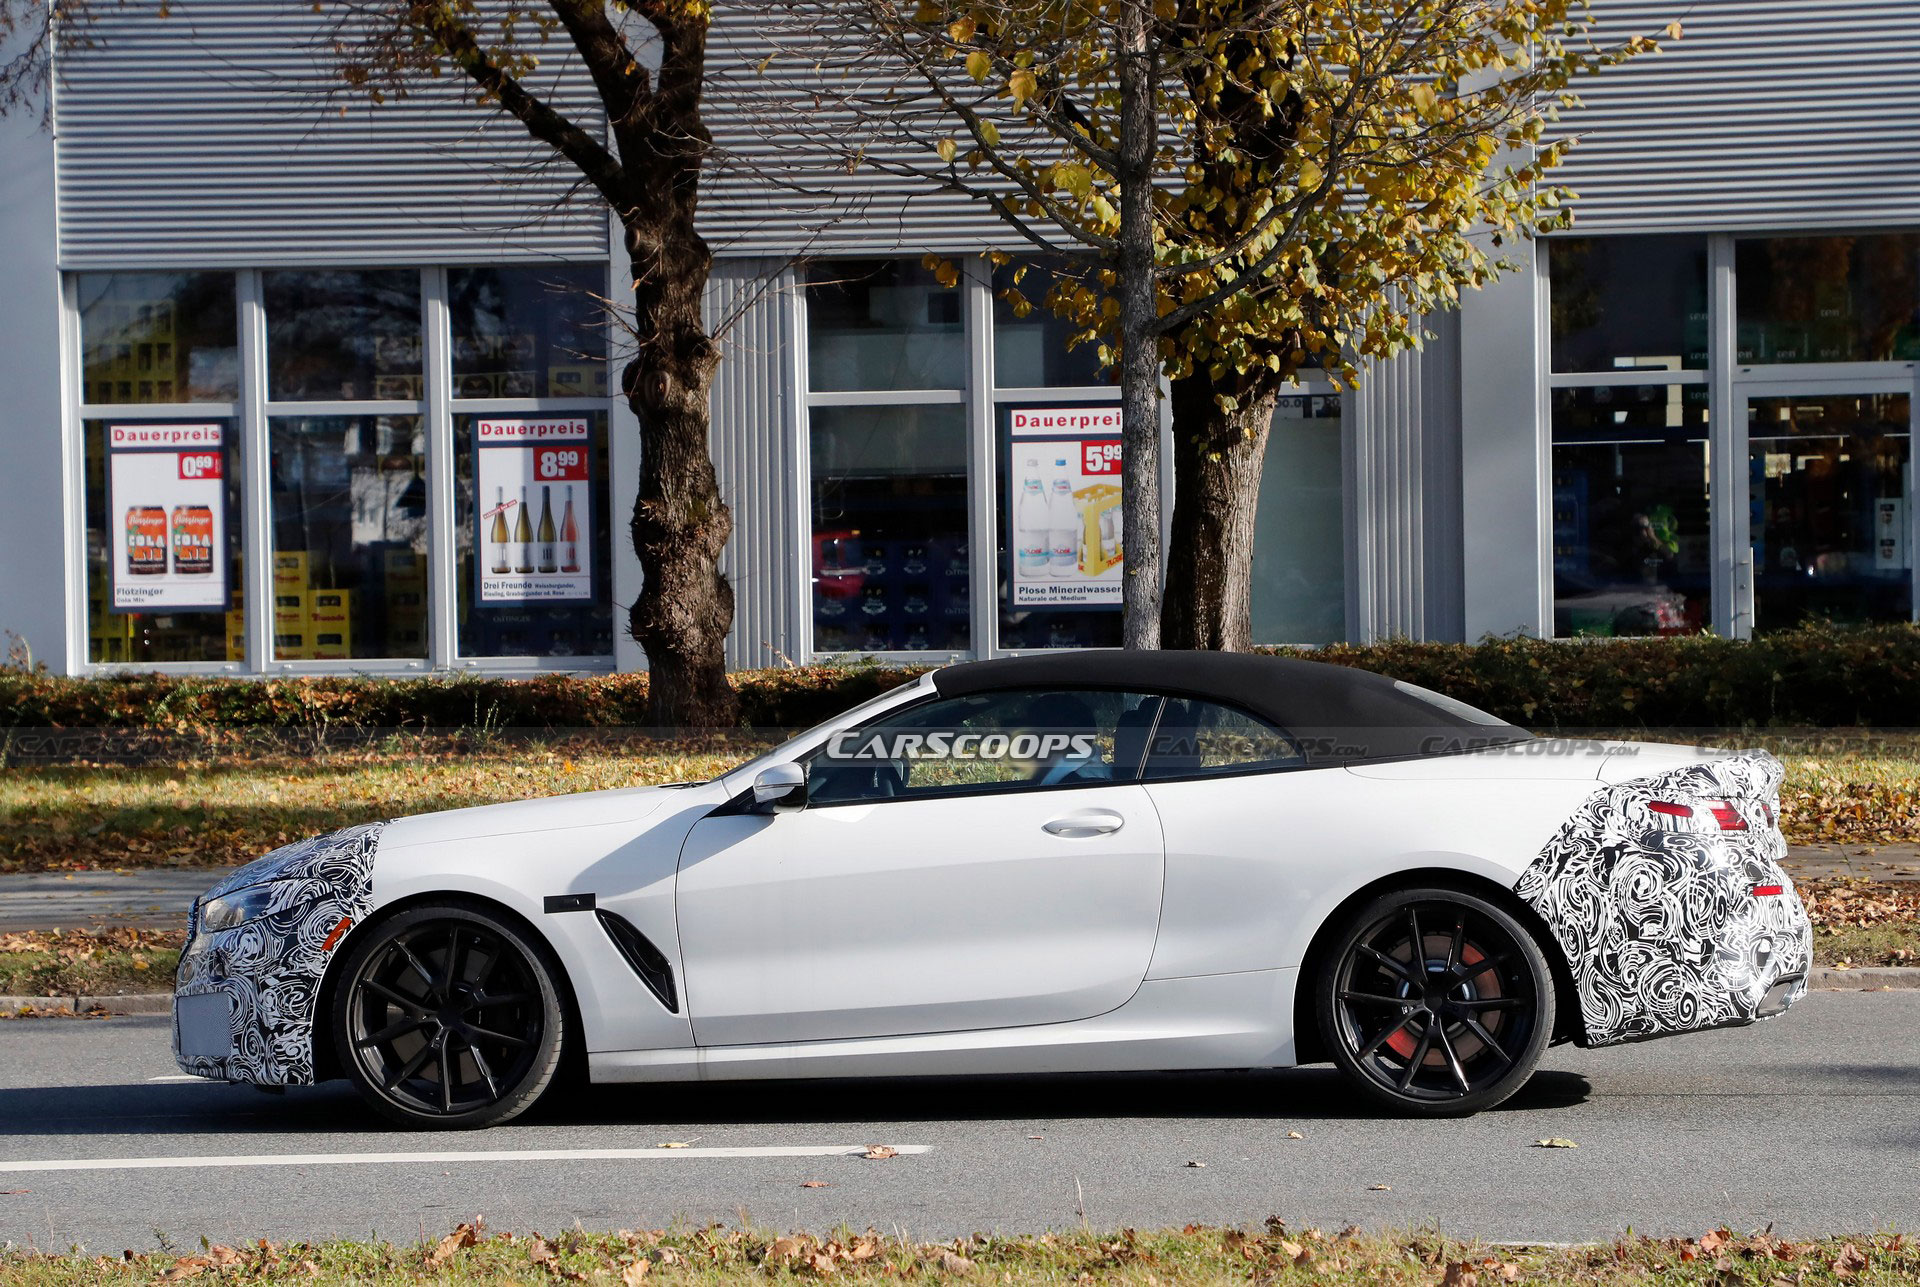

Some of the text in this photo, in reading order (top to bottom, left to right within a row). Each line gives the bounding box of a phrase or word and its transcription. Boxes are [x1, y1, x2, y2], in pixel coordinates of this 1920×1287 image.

[1015, 412, 1121, 429] Dauerprei
[114, 428, 220, 442] Dauerpreis
[481, 421, 585, 437] Dauerpreis
[501, 581, 533, 589] Freunde
[1018, 585, 1121, 594] Plose Mineralwasser
